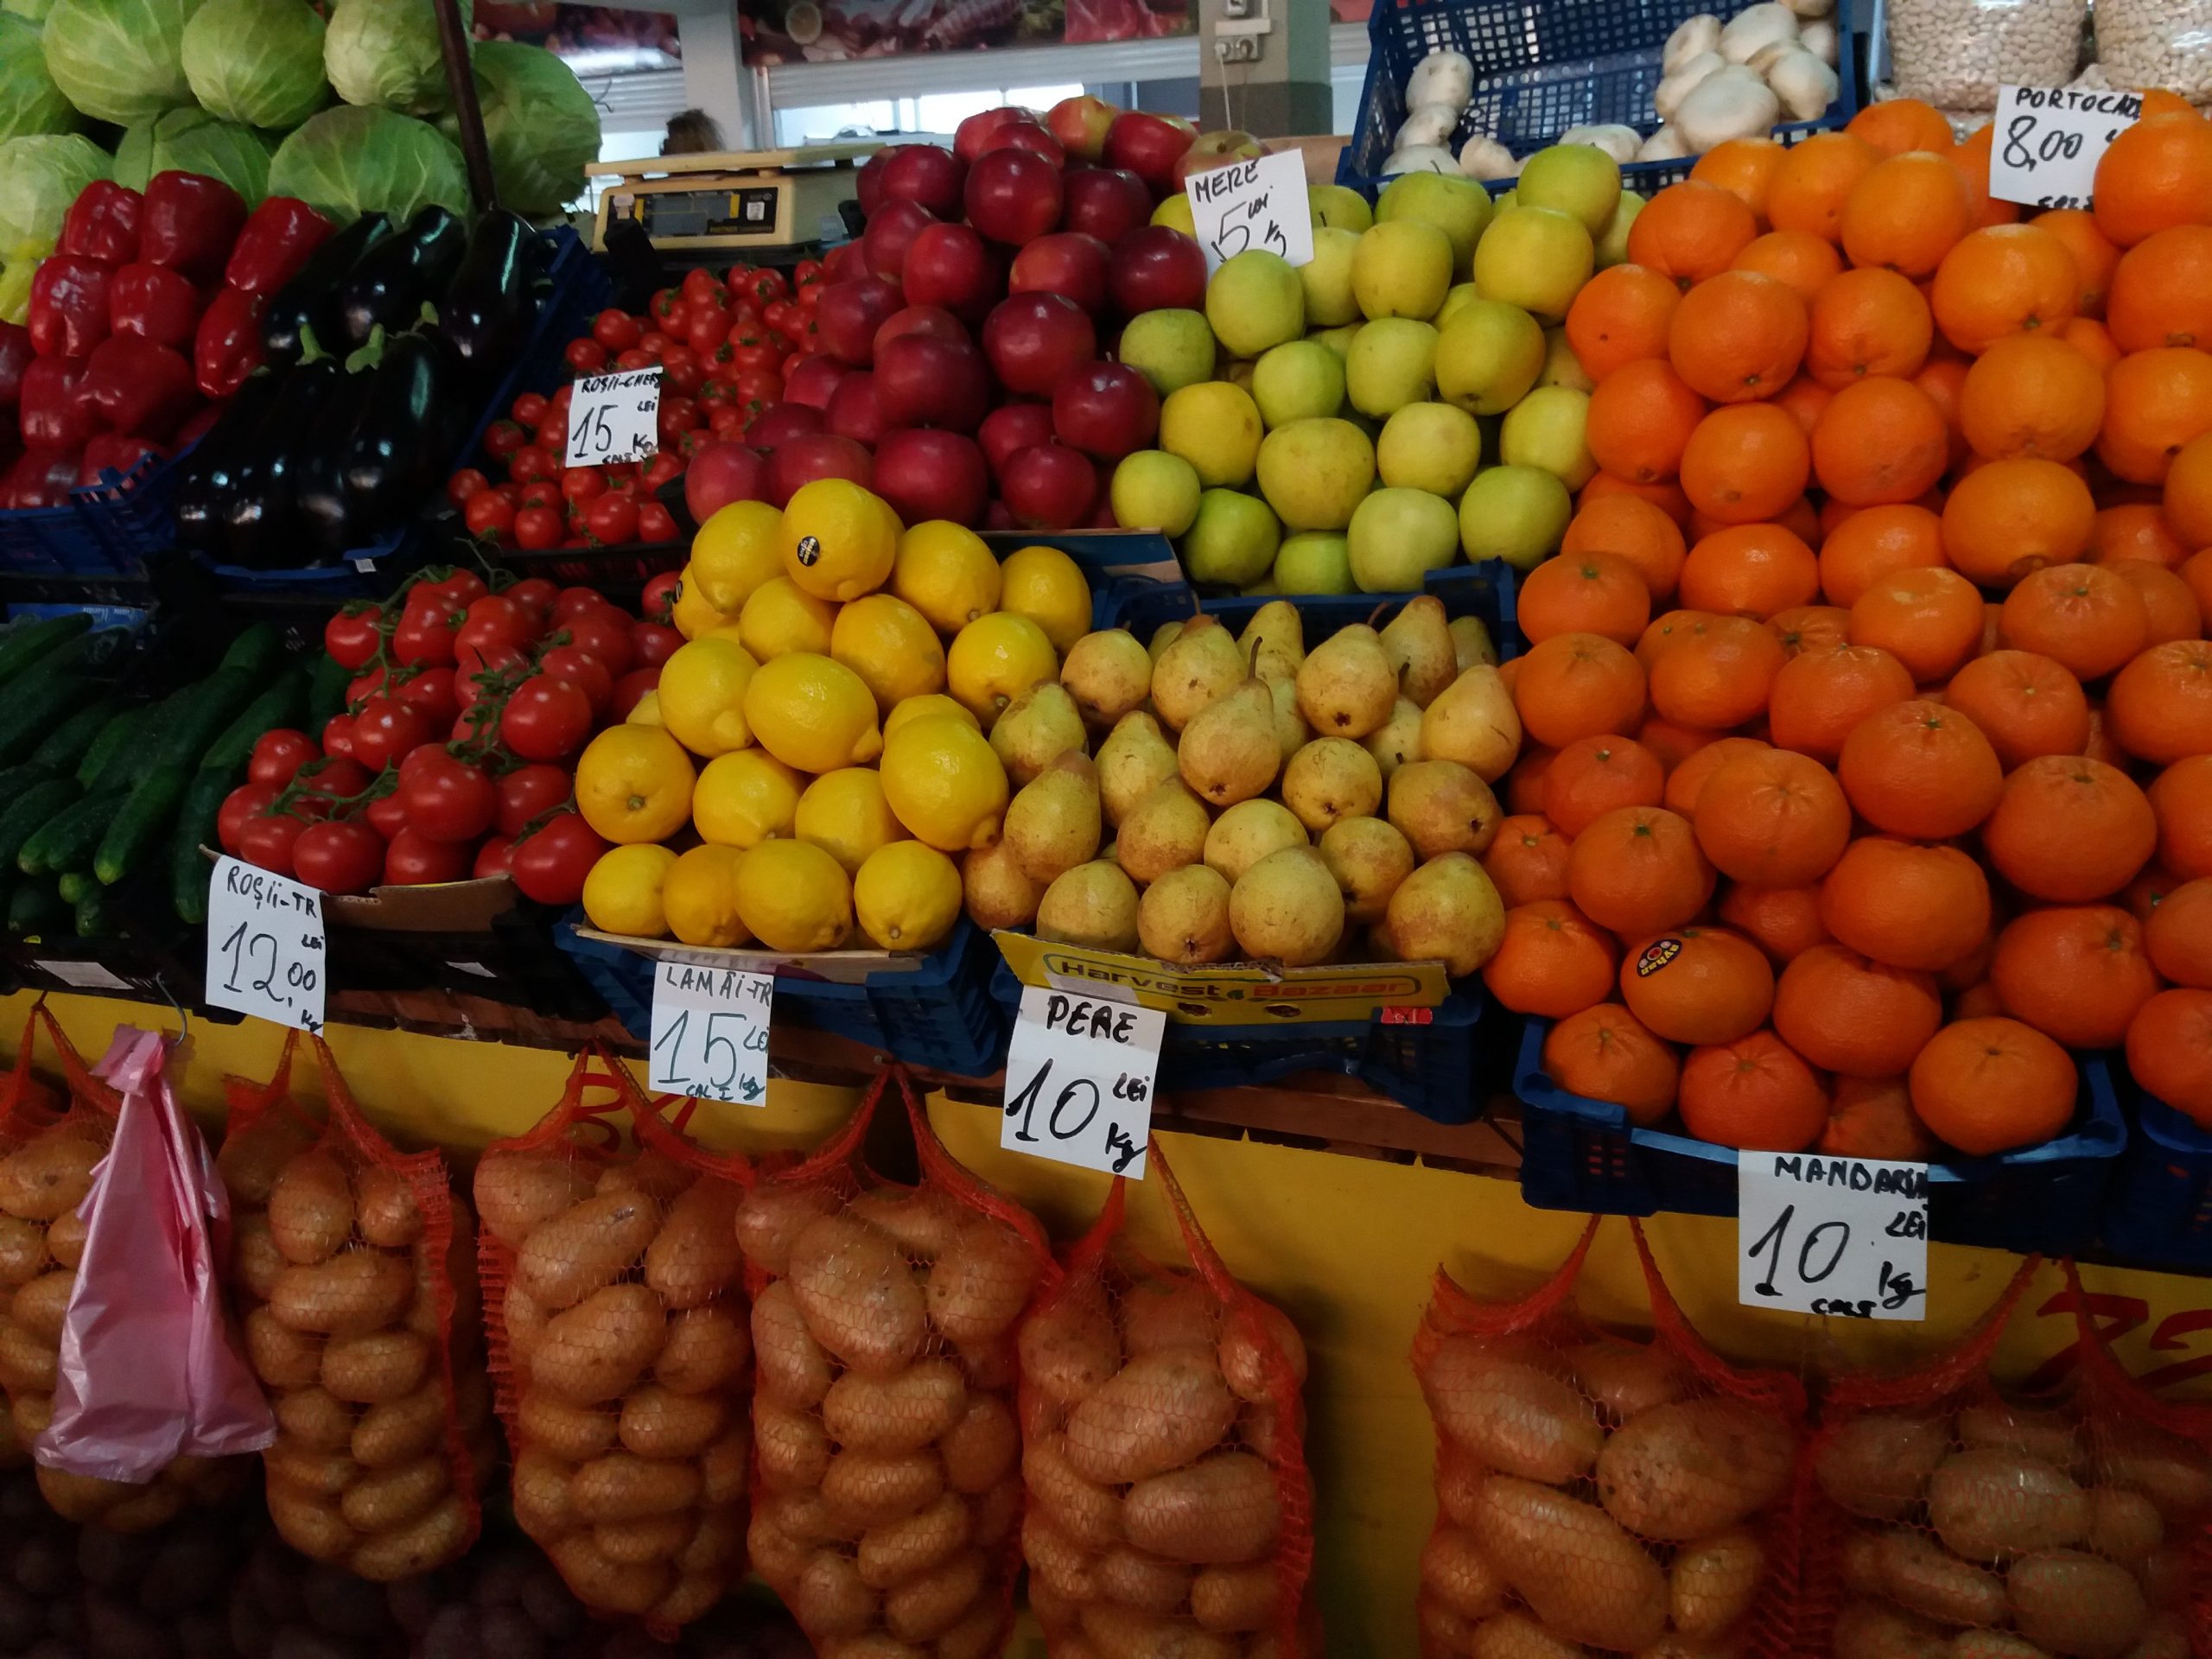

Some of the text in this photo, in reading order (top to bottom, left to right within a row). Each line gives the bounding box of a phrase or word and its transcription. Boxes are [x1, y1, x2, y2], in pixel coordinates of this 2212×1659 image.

[2002, 115, 2083, 172] 8,00
[1195, 158, 1261, 203] MERE
[1211, 200, 1250, 263] 5
[571, 404, 619, 458] 15
[1061, 960, 1411, 998] Harvest Bazaar
[1046, 995, 1138, 1044] PERE
[654, 1009, 747, 1089] 15
[1005, 1058, 1100, 1142] 10
[1748, 1204, 1851, 1297] 10
